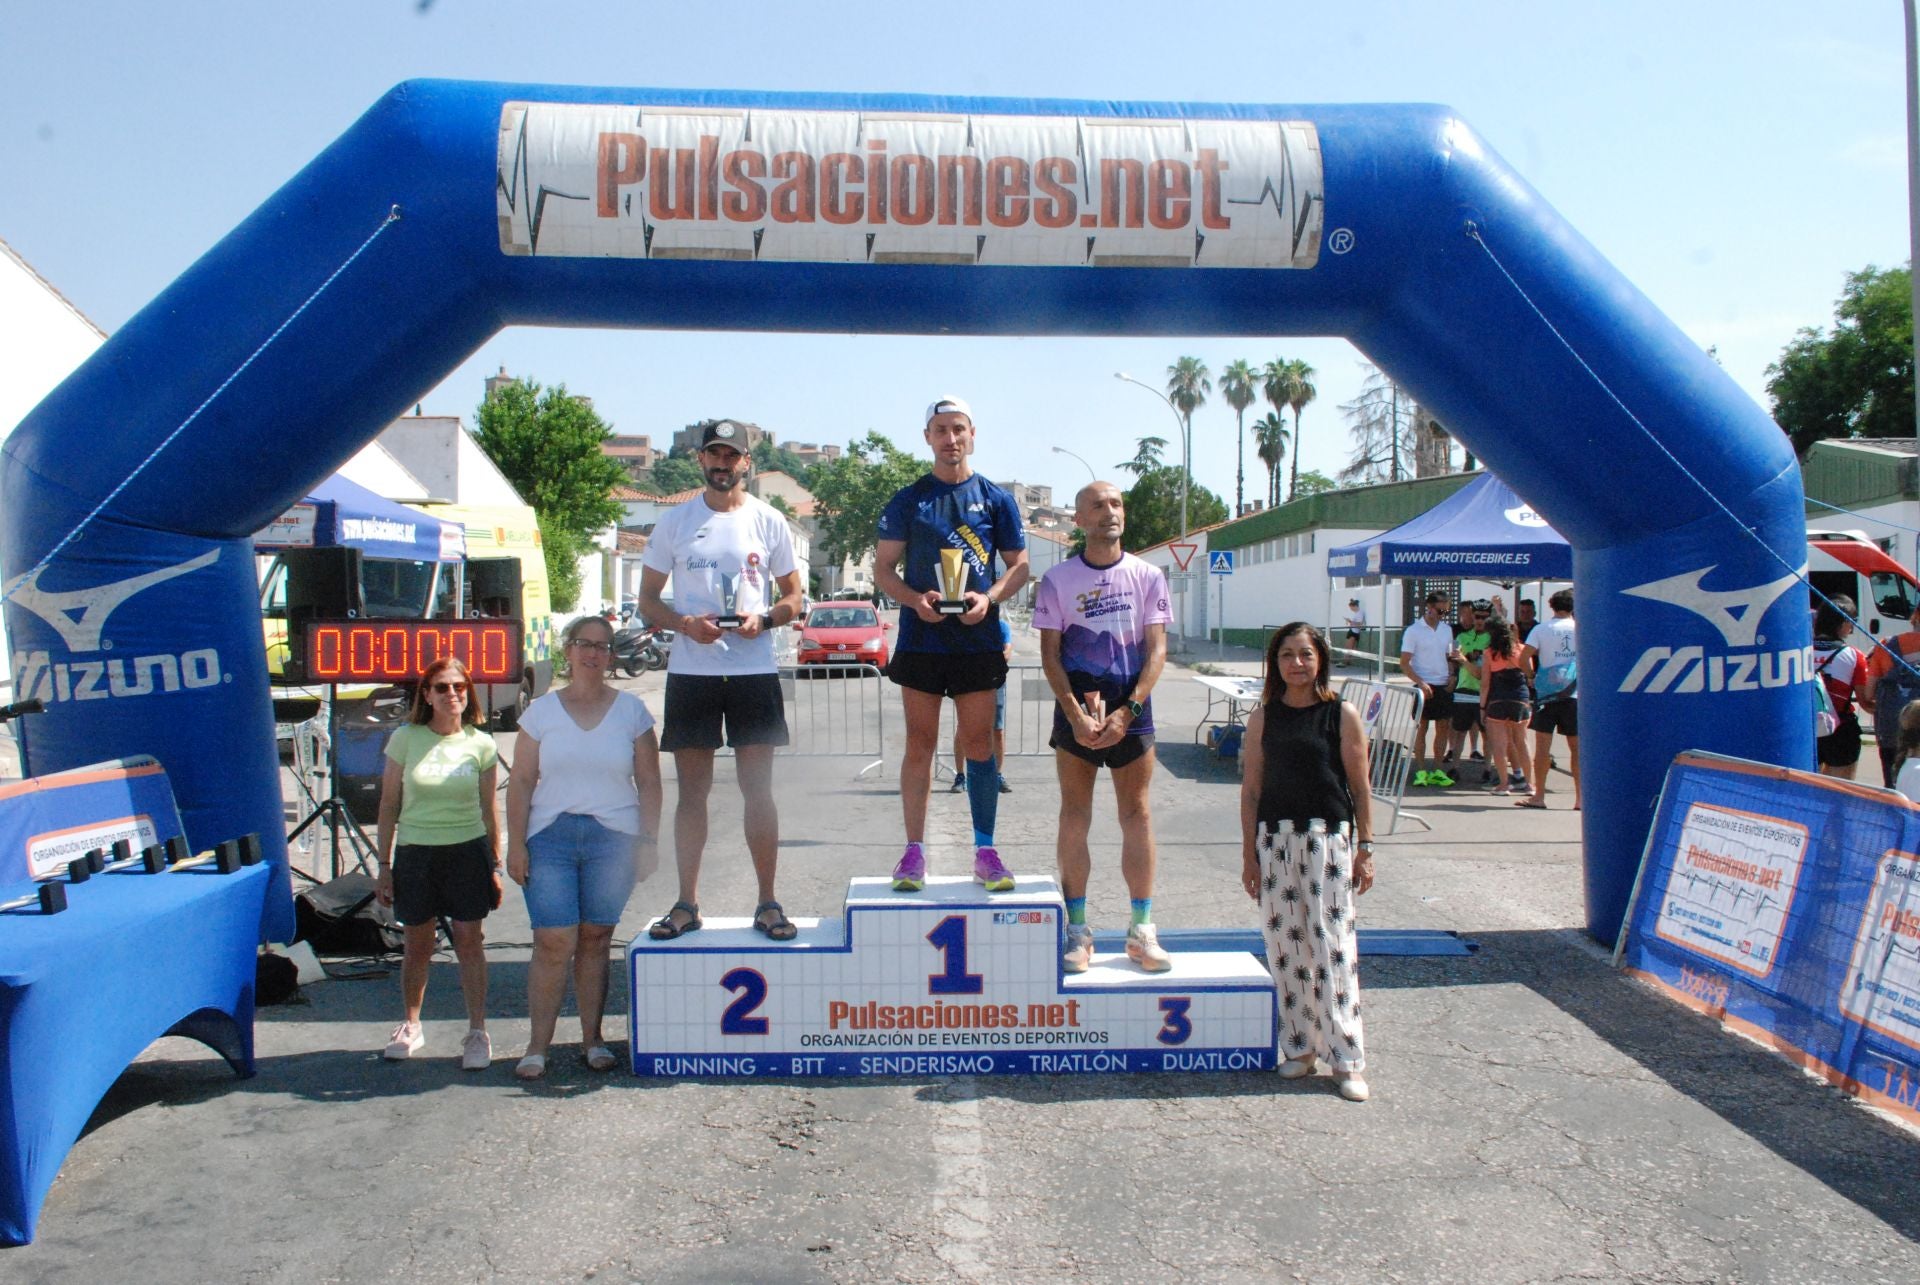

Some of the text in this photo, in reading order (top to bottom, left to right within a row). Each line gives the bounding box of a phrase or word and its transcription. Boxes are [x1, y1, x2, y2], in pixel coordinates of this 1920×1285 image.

[597, 132, 1231, 230] Pulsaciones.net
[1393, 551, 1531, 565] WWW.PROTEGEBIKE.ES
[926, 915, 983, 995] 1
[719, 967, 769, 1035] 2
[829, 999, 1080, 1030] Pulsaciones.net
[800, 1031, 1109, 1047] ORGANIZACIÓN DE EVENTOS DEPORTIVOS
[1156, 997, 1192, 1045] 3
[654, 1057, 756, 1075] RUNNING
[791, 1057, 826, 1074] BTT
[860, 1055, 994, 1074] SENDERISMO
[1029, 1050, 1127, 1072] TRIATLÓN
[1163, 1049, 1262, 1070] DUATLÓN
